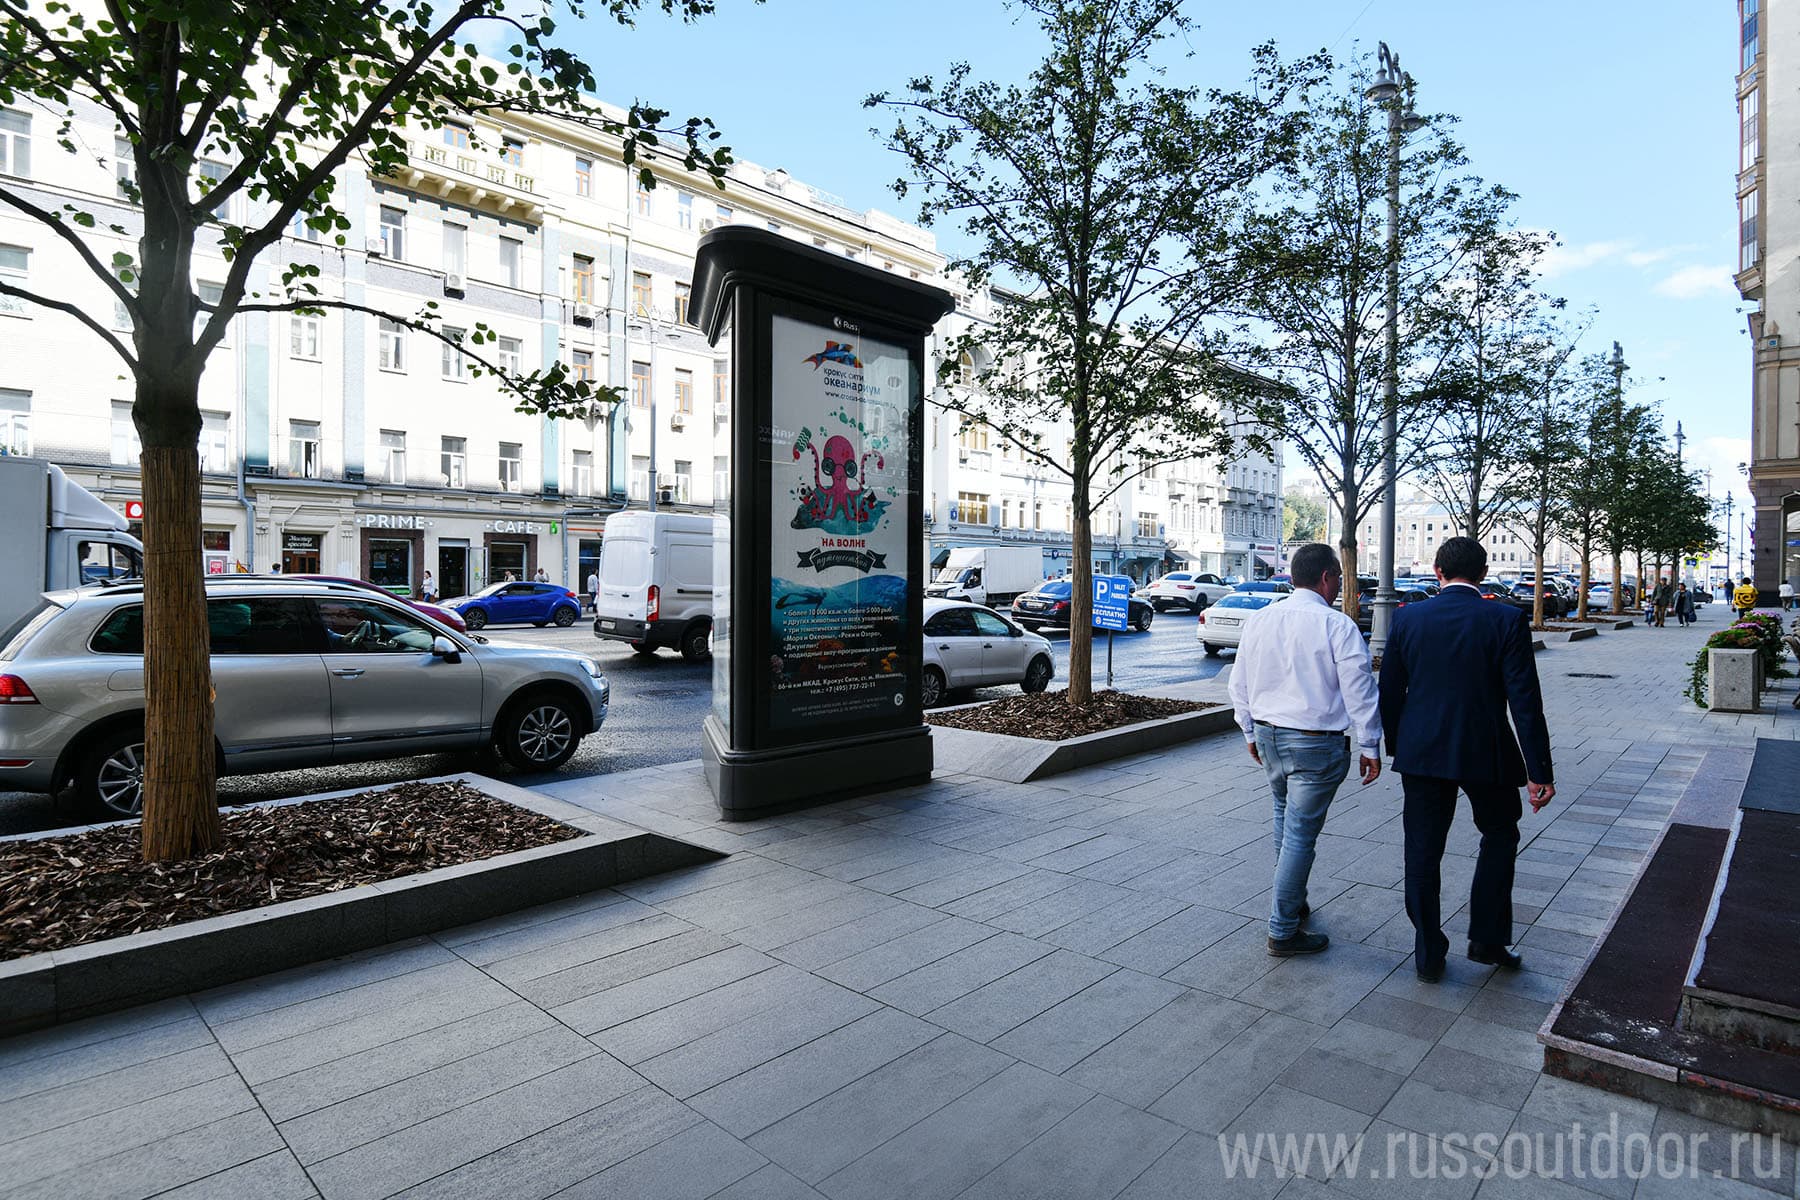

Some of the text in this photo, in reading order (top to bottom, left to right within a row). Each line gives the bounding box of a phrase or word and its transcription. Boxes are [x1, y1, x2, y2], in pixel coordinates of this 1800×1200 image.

[823, 377, 881, 395] океанариум
[366, 514, 534, 533] PRIME CAFE
[822, 538, 866, 547] НА ВОЛНЕ
[1096, 580, 1109, 601] P
[1092, 608, 1127, 619] БЕСПЛАТНО
